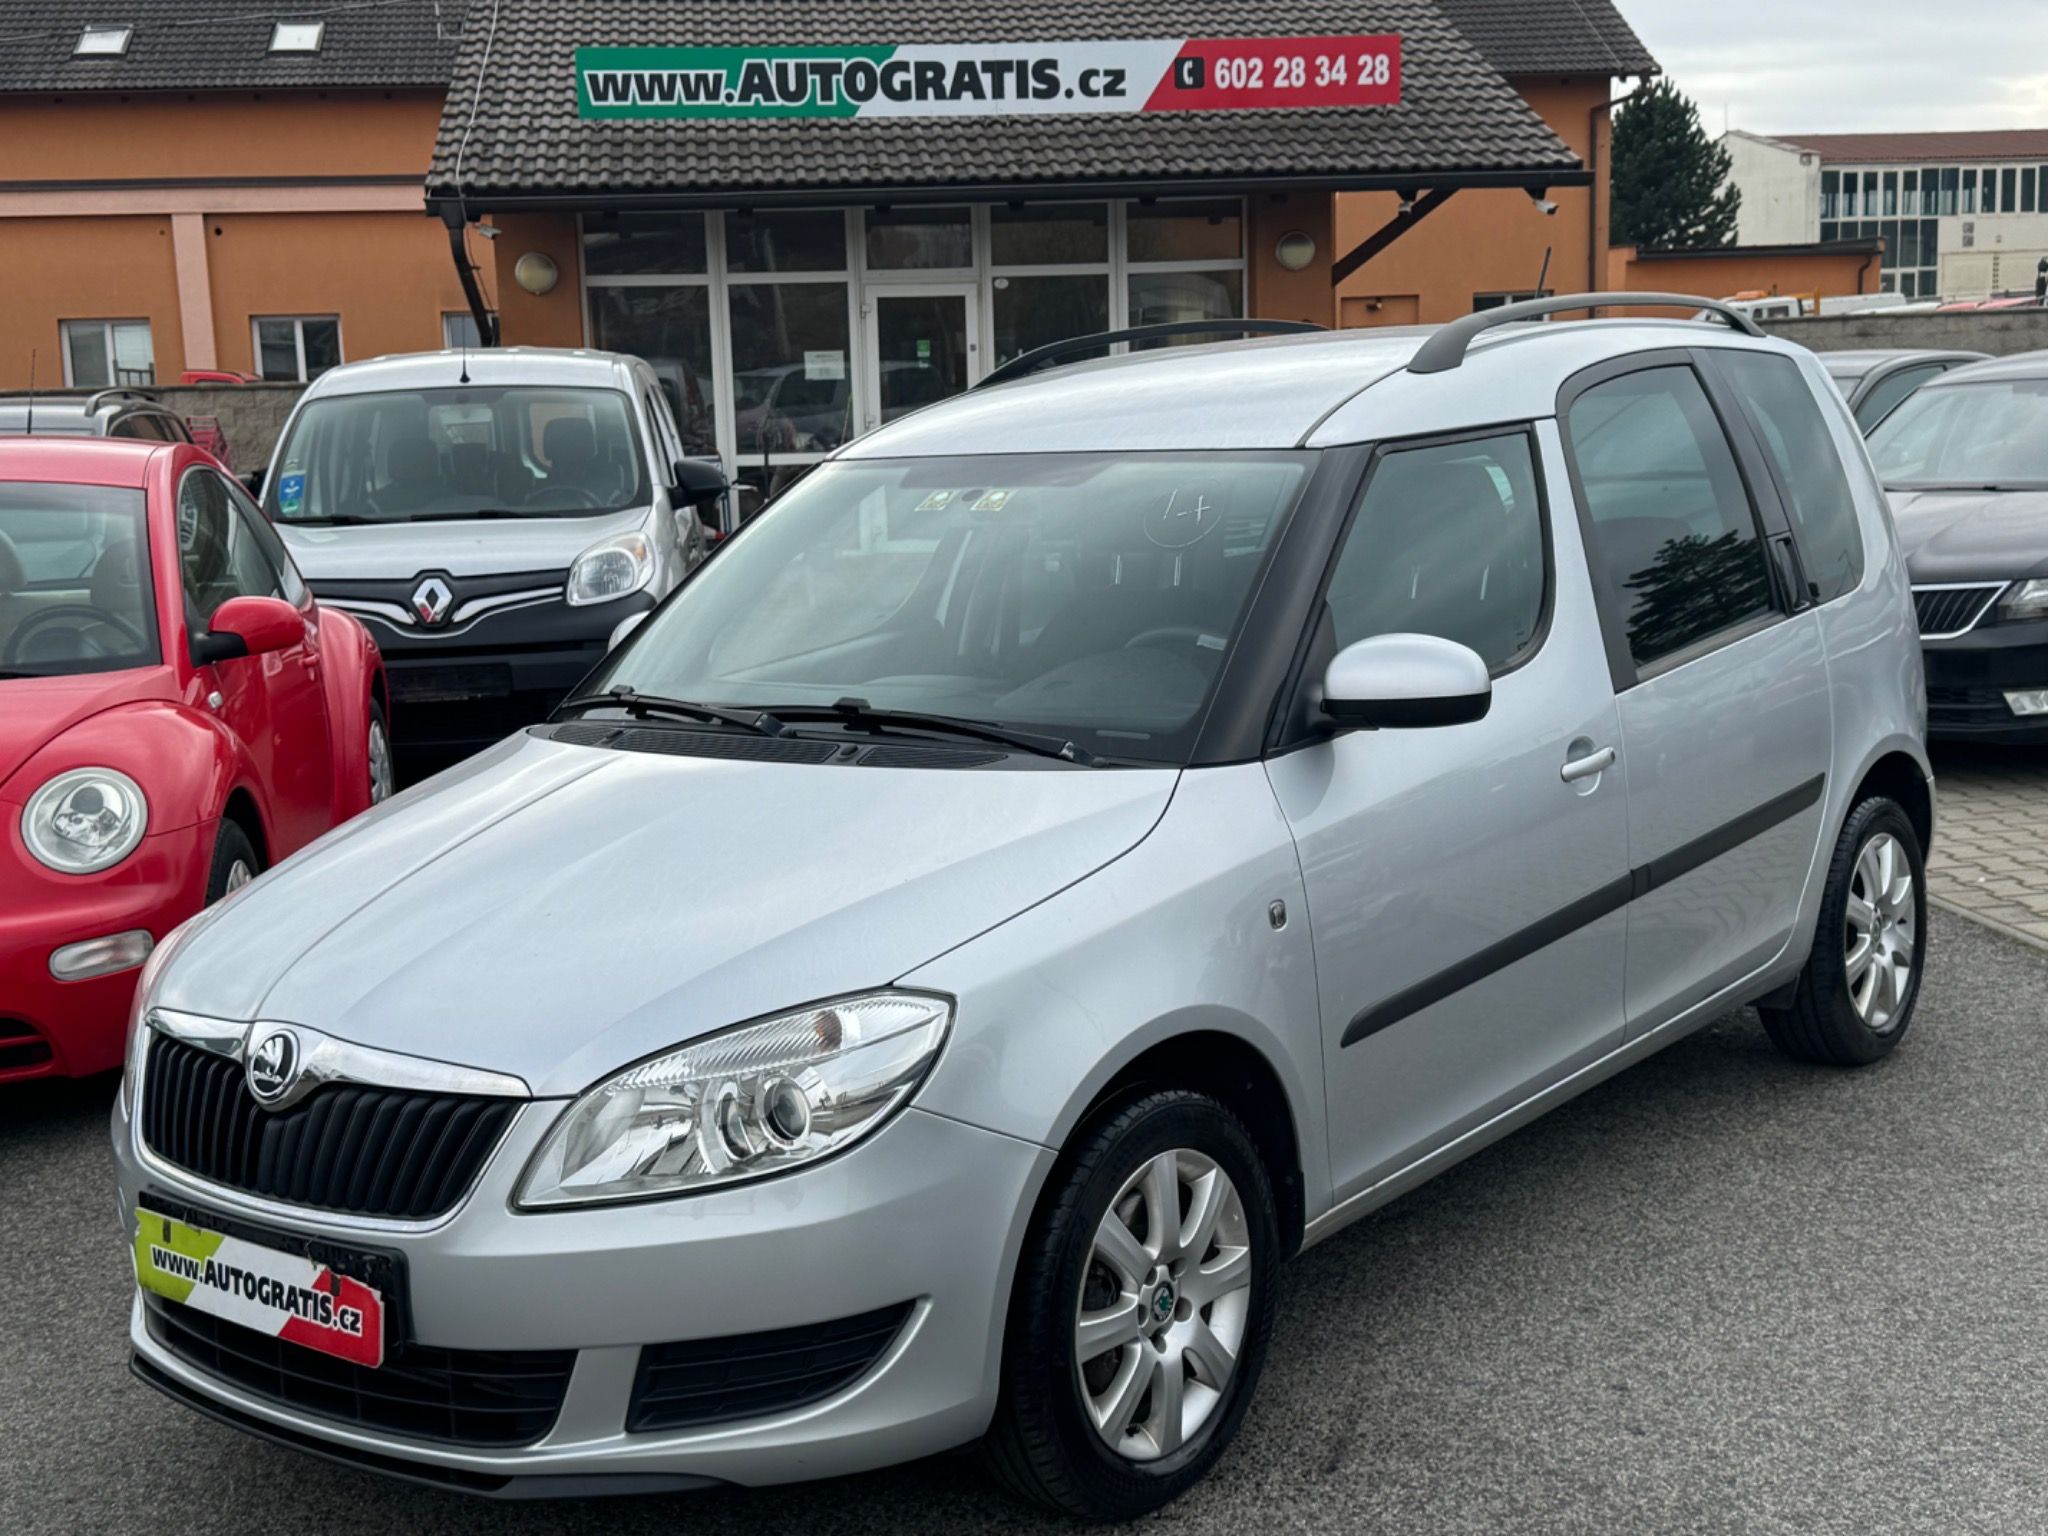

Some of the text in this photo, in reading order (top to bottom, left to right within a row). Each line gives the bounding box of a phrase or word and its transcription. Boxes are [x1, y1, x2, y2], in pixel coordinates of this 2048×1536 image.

[585, 53, 1391, 105] www.AUTOGRATIS.cz 602 28 34 28
[151, 1245, 362, 1335] www.AUTOGRATIS.cz
